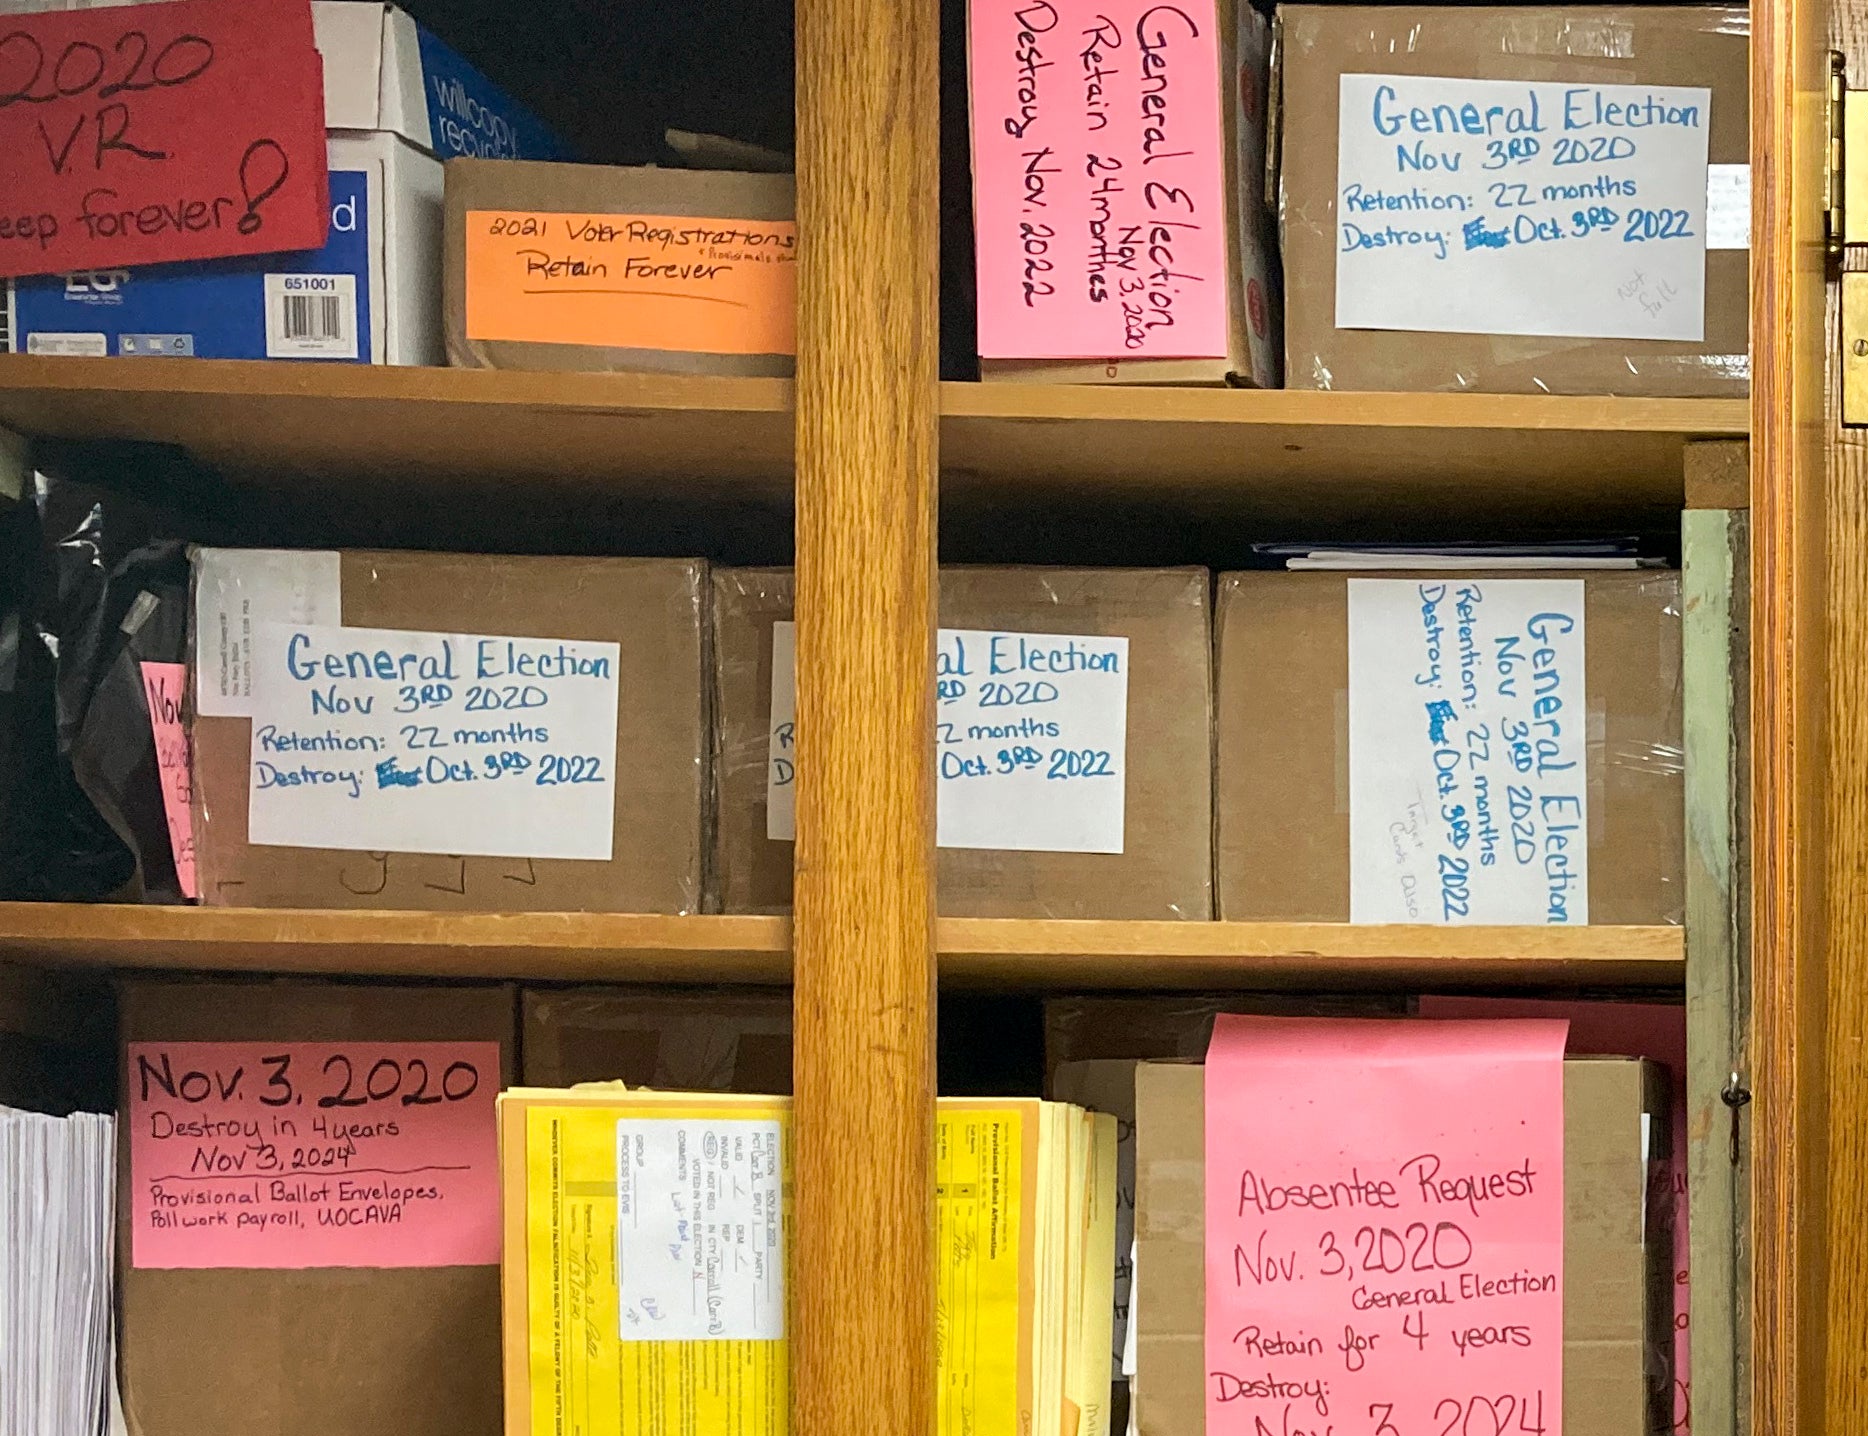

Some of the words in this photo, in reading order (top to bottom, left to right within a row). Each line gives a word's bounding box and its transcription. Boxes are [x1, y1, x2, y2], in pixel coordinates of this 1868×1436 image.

[0, 30, 216, 105] 2020
[1004, 0, 1058, 138] Destroy
[1079, 14, 1122, 131] Retain
[1136, 5, 1199, 165] General
[1372, 85, 1546, 136] General
[1564, 88, 1700, 130] Election
[1396, 145, 1462, 173] Nov
[1481, 140, 1541, 171] 3RD
[1552, 136, 1637, 165] 2020
[1344, 184, 1474, 213] Retention:
[1488, 181, 1529, 208] 22
[1541, 176, 1638, 202] months
[489, 216, 548, 239] 2021
[1342, 224, 1452, 260] Destroy:
[1514, 214, 1569, 245] Oct.
[1570, 205, 1621, 239] 3RD
[1624, 209, 1694, 241] 2022
[518, 249, 608, 279] Retain
[624, 259, 733, 281] Forever
[1021, 223, 1055, 307] 2022
[1144, 182, 1204, 330] Election
[283, 278, 338, 292] 651001
[287, 632, 459, 682] General
[476, 639, 611, 681] Election
[1526, 610, 1576, 780] General
[1540, 793, 1584, 925] Election
[138, 1053, 244, 1104] Nov.
[320, 1055, 479, 1108] 2020
[151, 1110, 264, 1147] Destroy
[272, 1116, 302, 1138] in
[150, 1184, 262, 1208] Provisional
[270, 1183, 332, 1204] Ballot
[1239, 1169, 1400, 1217] Absentee
[1399, 1154, 1537, 1217] Request
[1352, 1283, 1456, 1311] General
[1460, 1271, 1557, 1298] Election
[1233, 1326, 1323, 1359] Retain
[1338, 1326, 1381, 1373] for
[1402, 1310, 1429, 1352] 4
[1452, 1321, 1532, 1357] years
[1209, 1372, 1331, 1417] Destroy:
